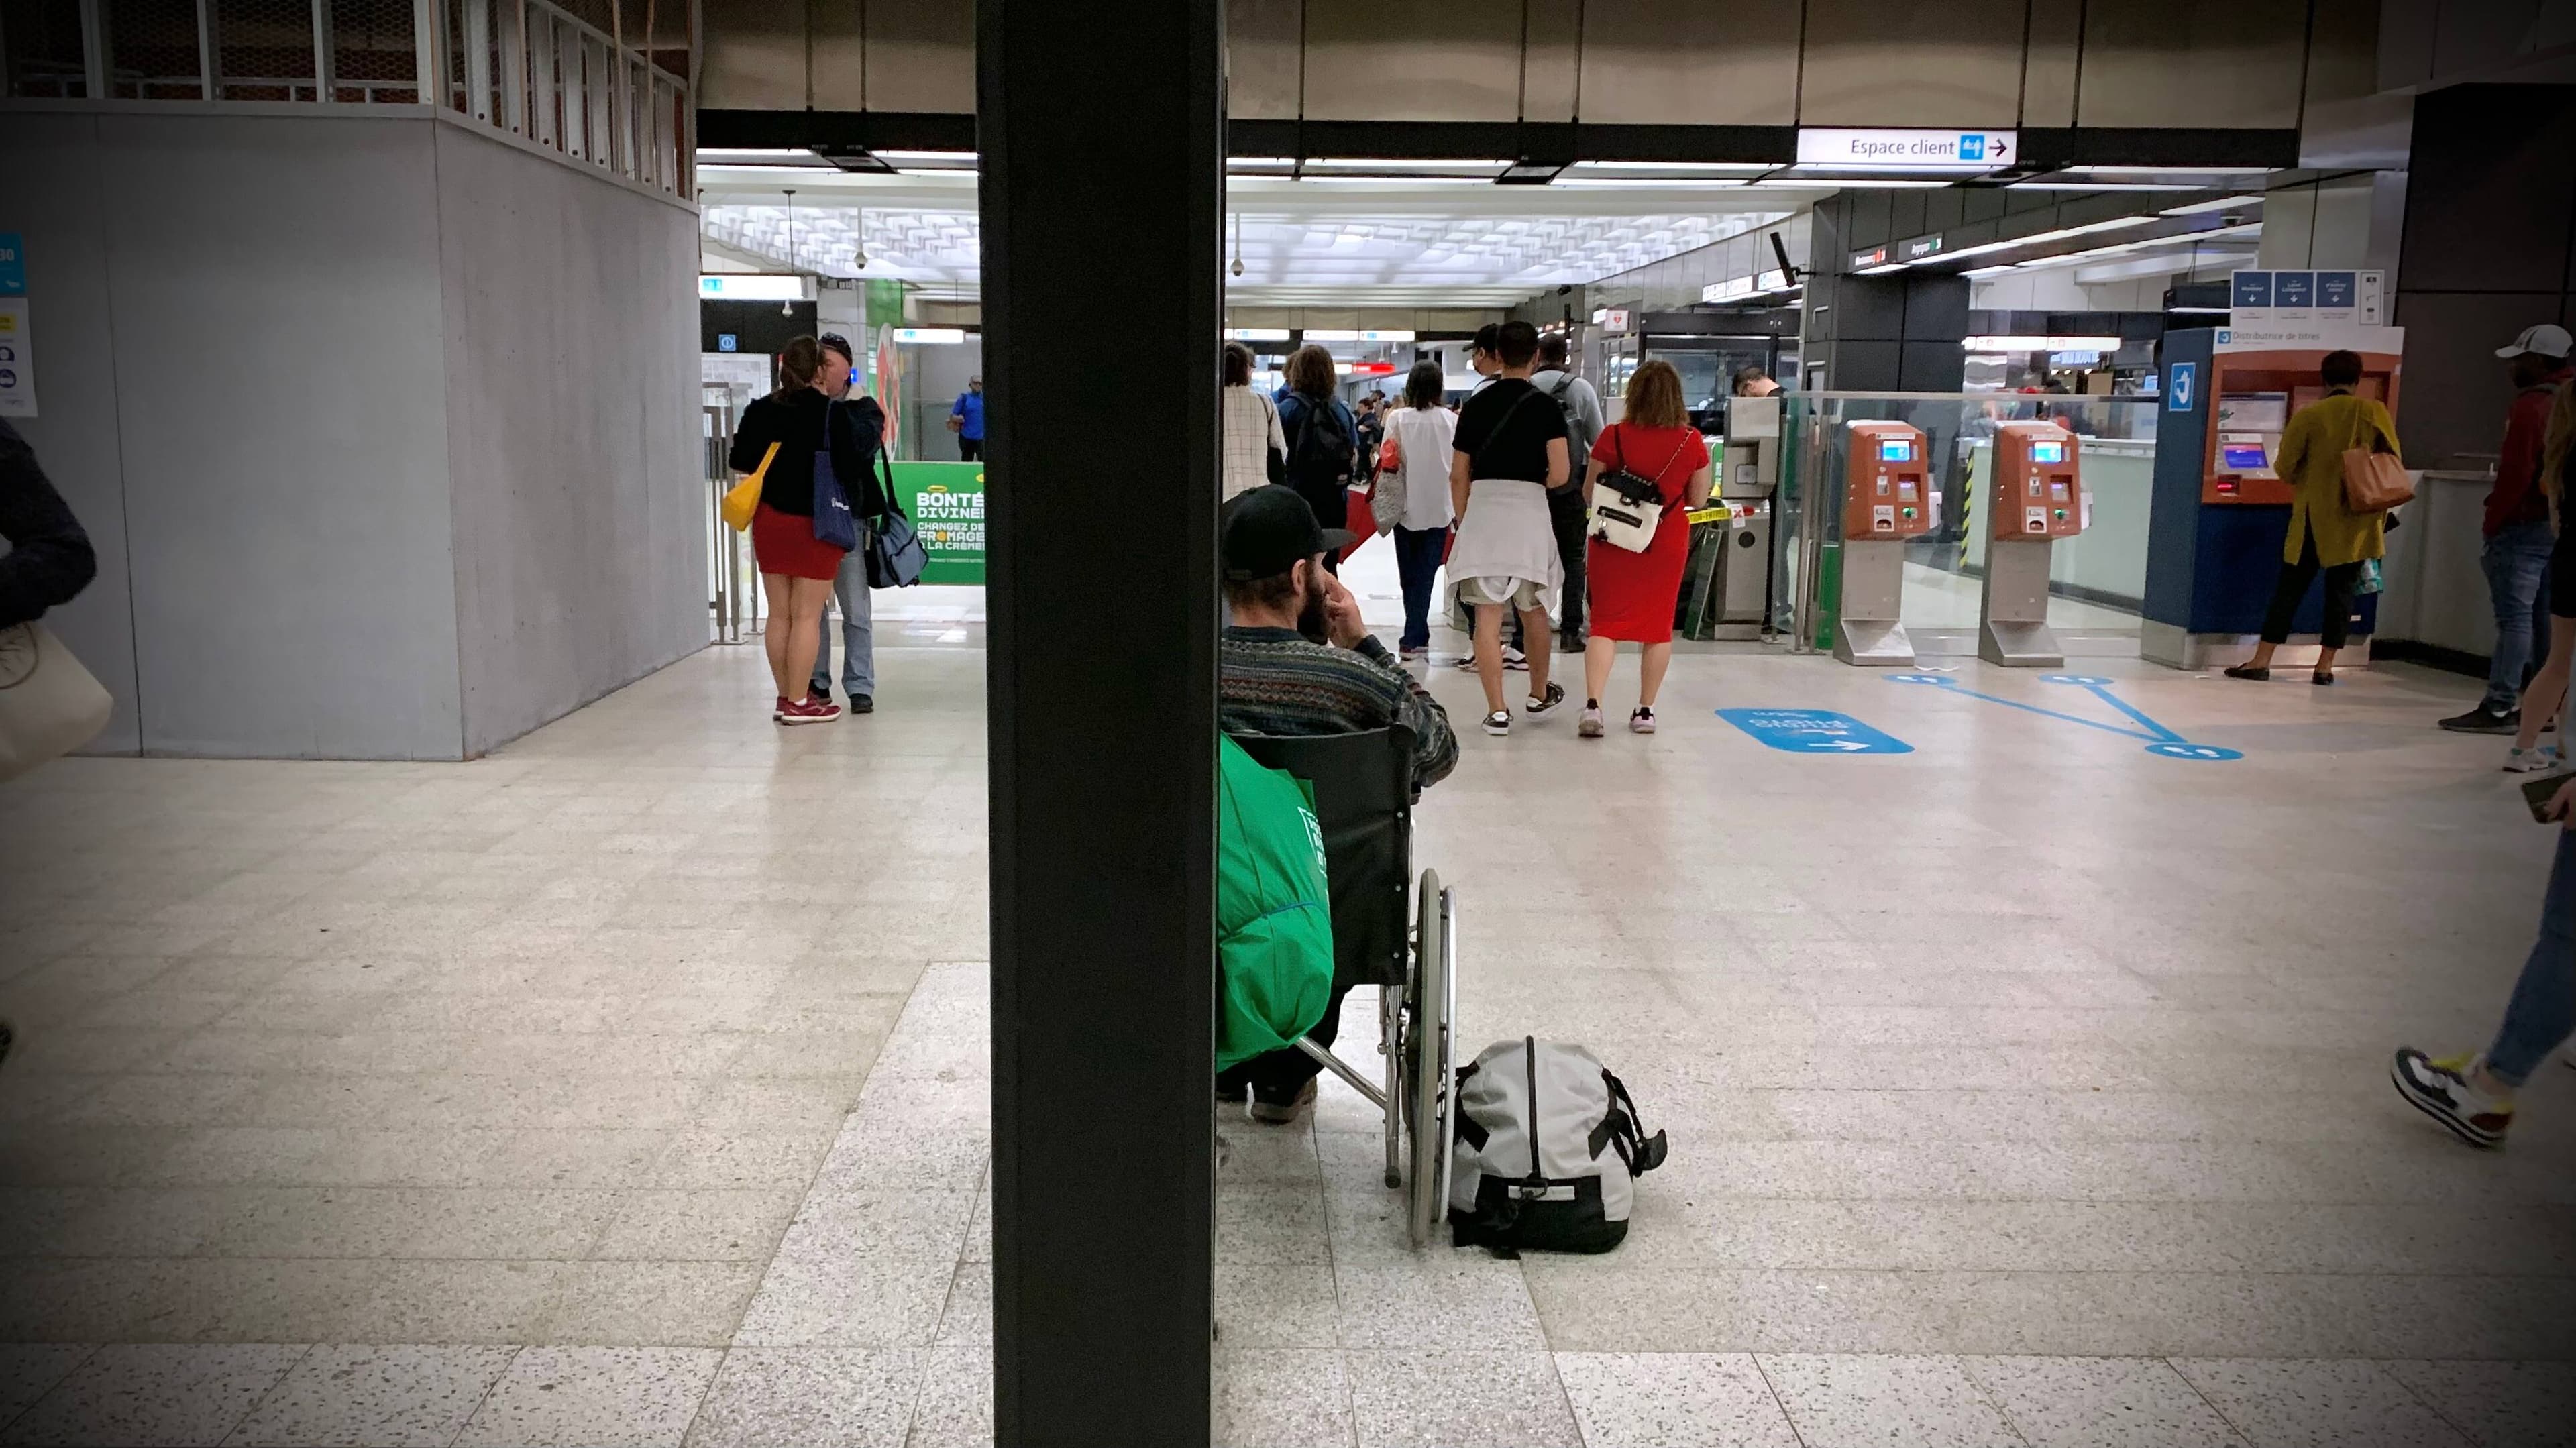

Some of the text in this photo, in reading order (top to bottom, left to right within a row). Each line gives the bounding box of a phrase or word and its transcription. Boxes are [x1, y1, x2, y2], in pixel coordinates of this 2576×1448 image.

[1851, 139, 1955, 158] Espace client
[2232, 331, 2321, 341] Distributrice de titres
[916, 491, 985, 507] BONTÉ
[917, 507, 985, 519] DIVINE!
[917, 522, 985, 531] CHANGEZ DE
[917, 531, 985, 542] FROMAGE
[927, 541, 943, 550] LA
